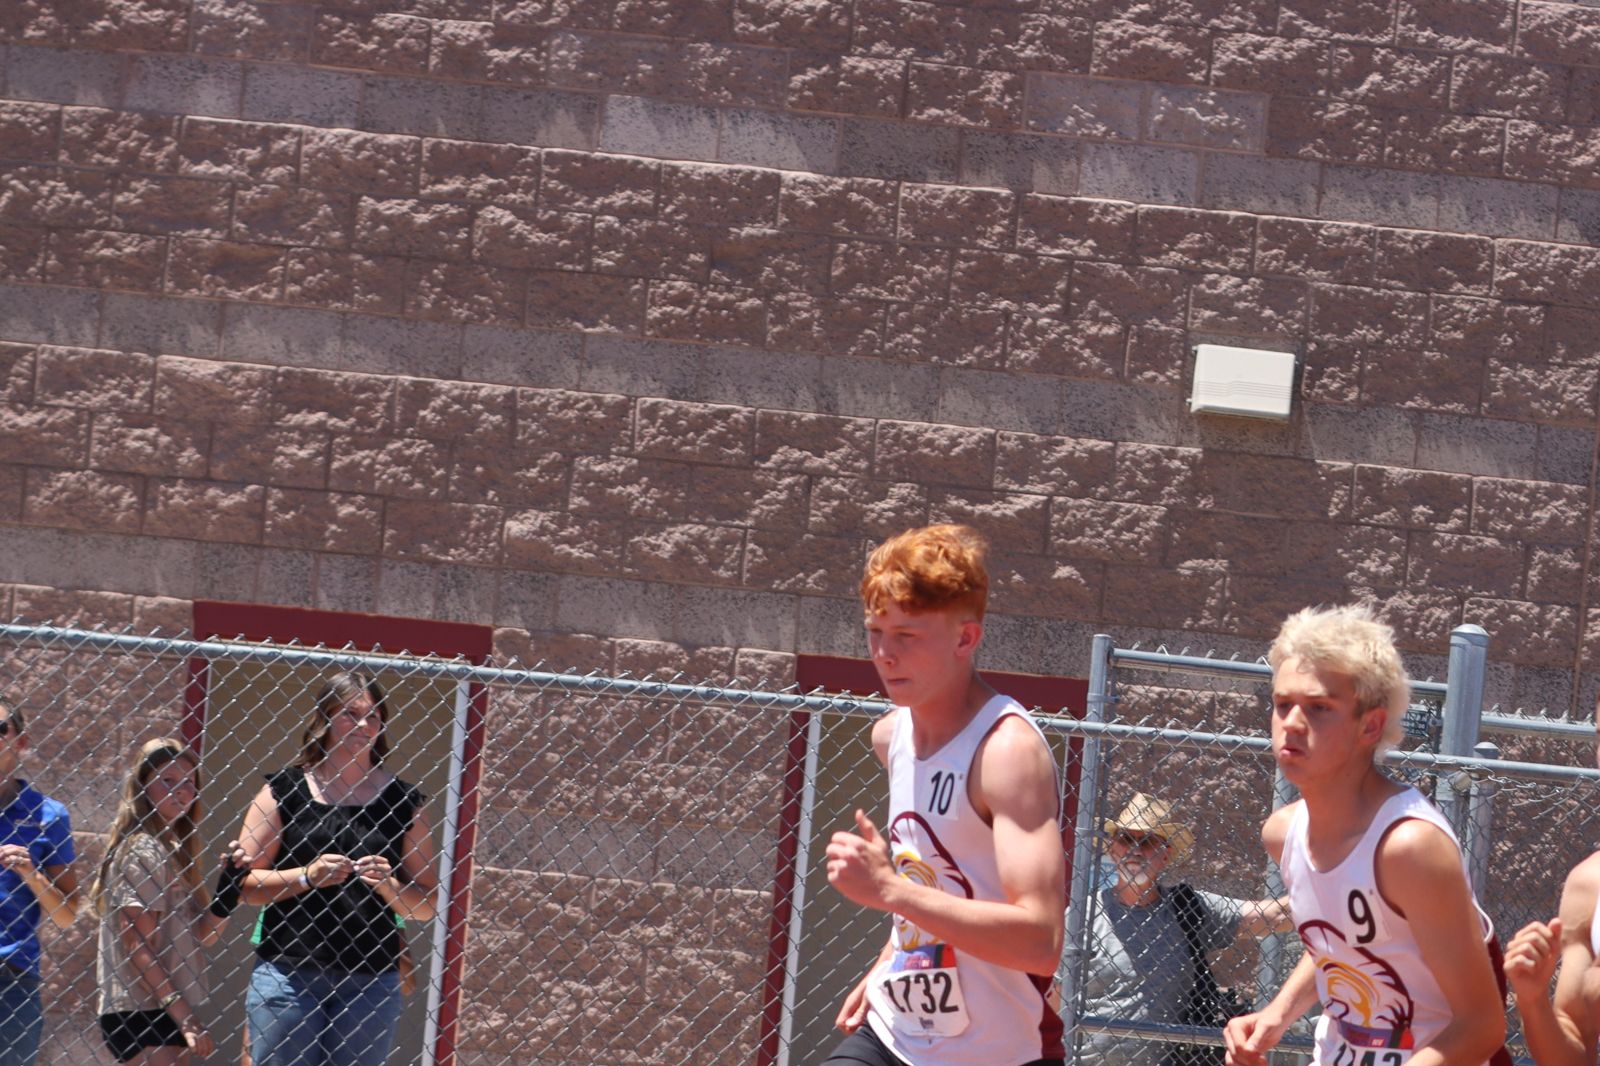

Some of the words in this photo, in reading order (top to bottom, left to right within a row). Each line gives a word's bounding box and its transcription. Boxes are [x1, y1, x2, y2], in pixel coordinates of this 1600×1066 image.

[928, 770, 955, 816] 10
[1348, 889, 1376, 944] 9
[884, 972, 959, 1014] 1732
